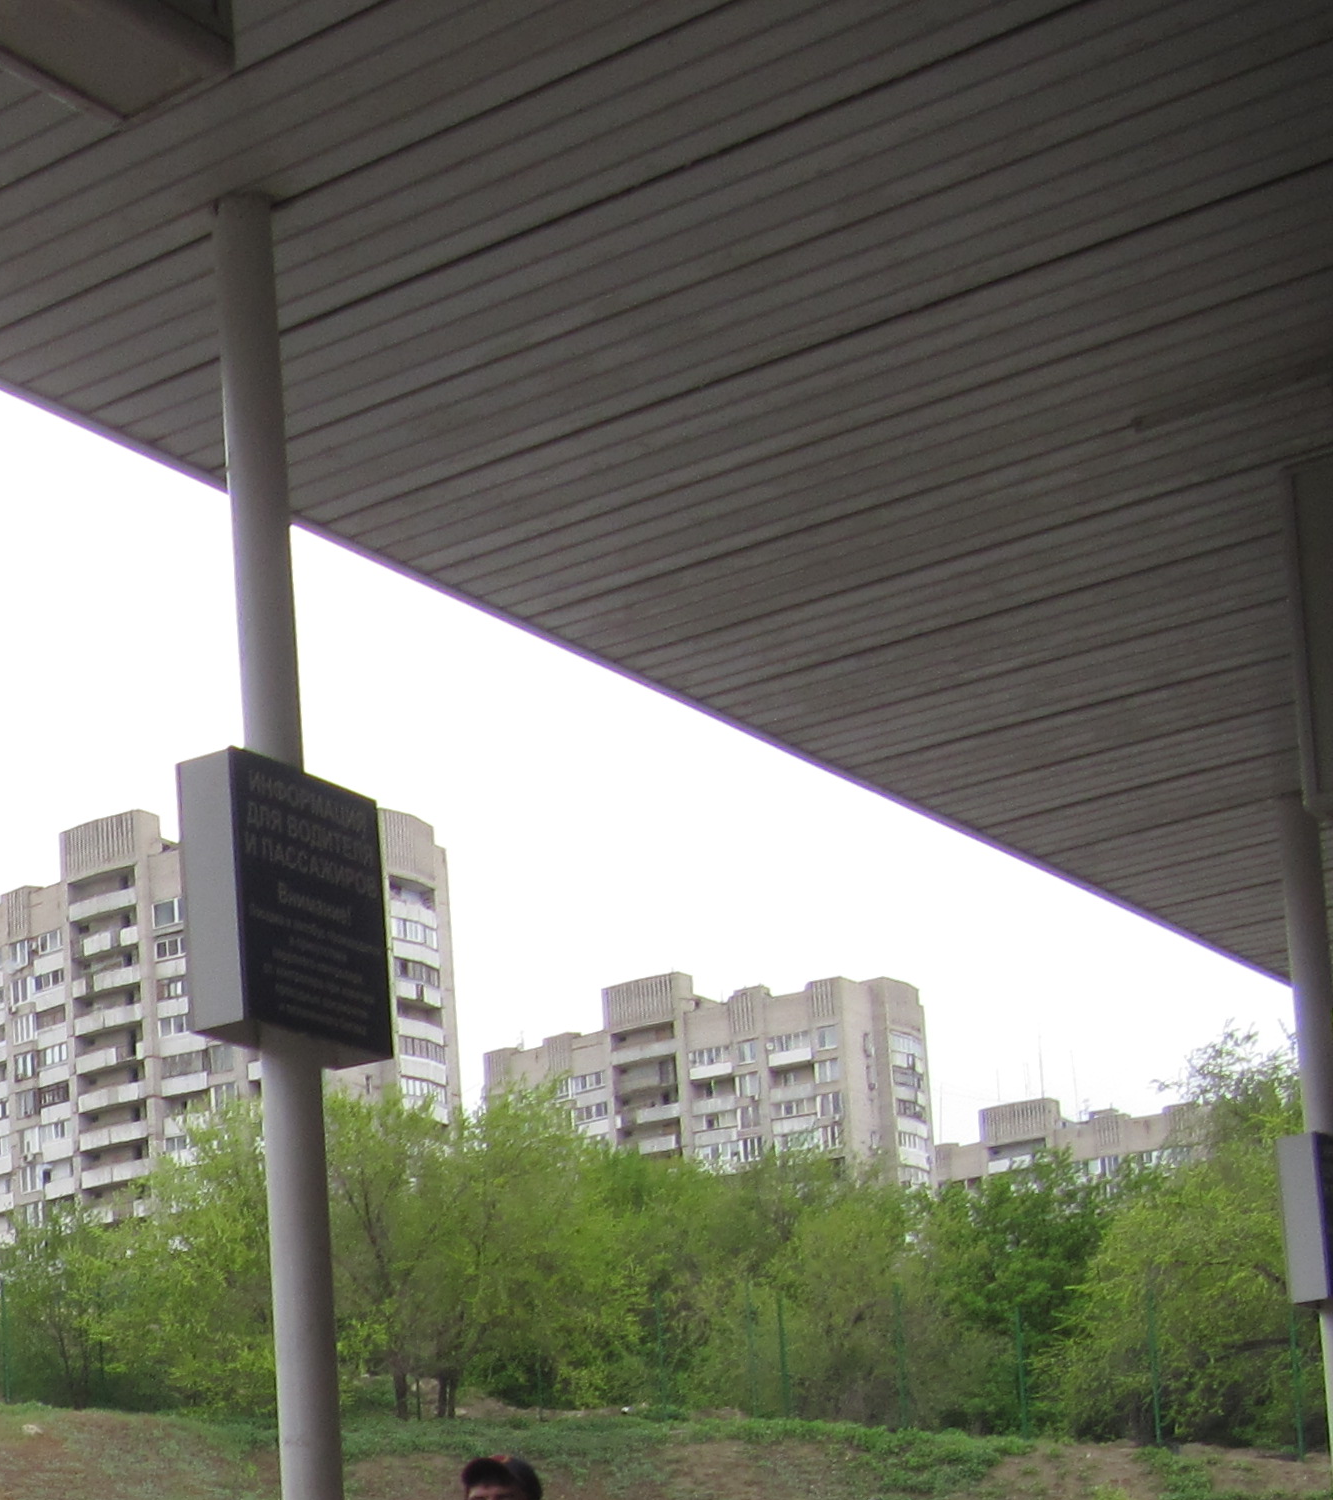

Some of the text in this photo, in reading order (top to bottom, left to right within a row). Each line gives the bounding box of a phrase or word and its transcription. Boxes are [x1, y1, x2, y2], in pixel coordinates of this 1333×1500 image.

[247, 800, 282, 832] ДЛЯ
[245, 831, 378, 899] И ПАССАЖИРОВ
